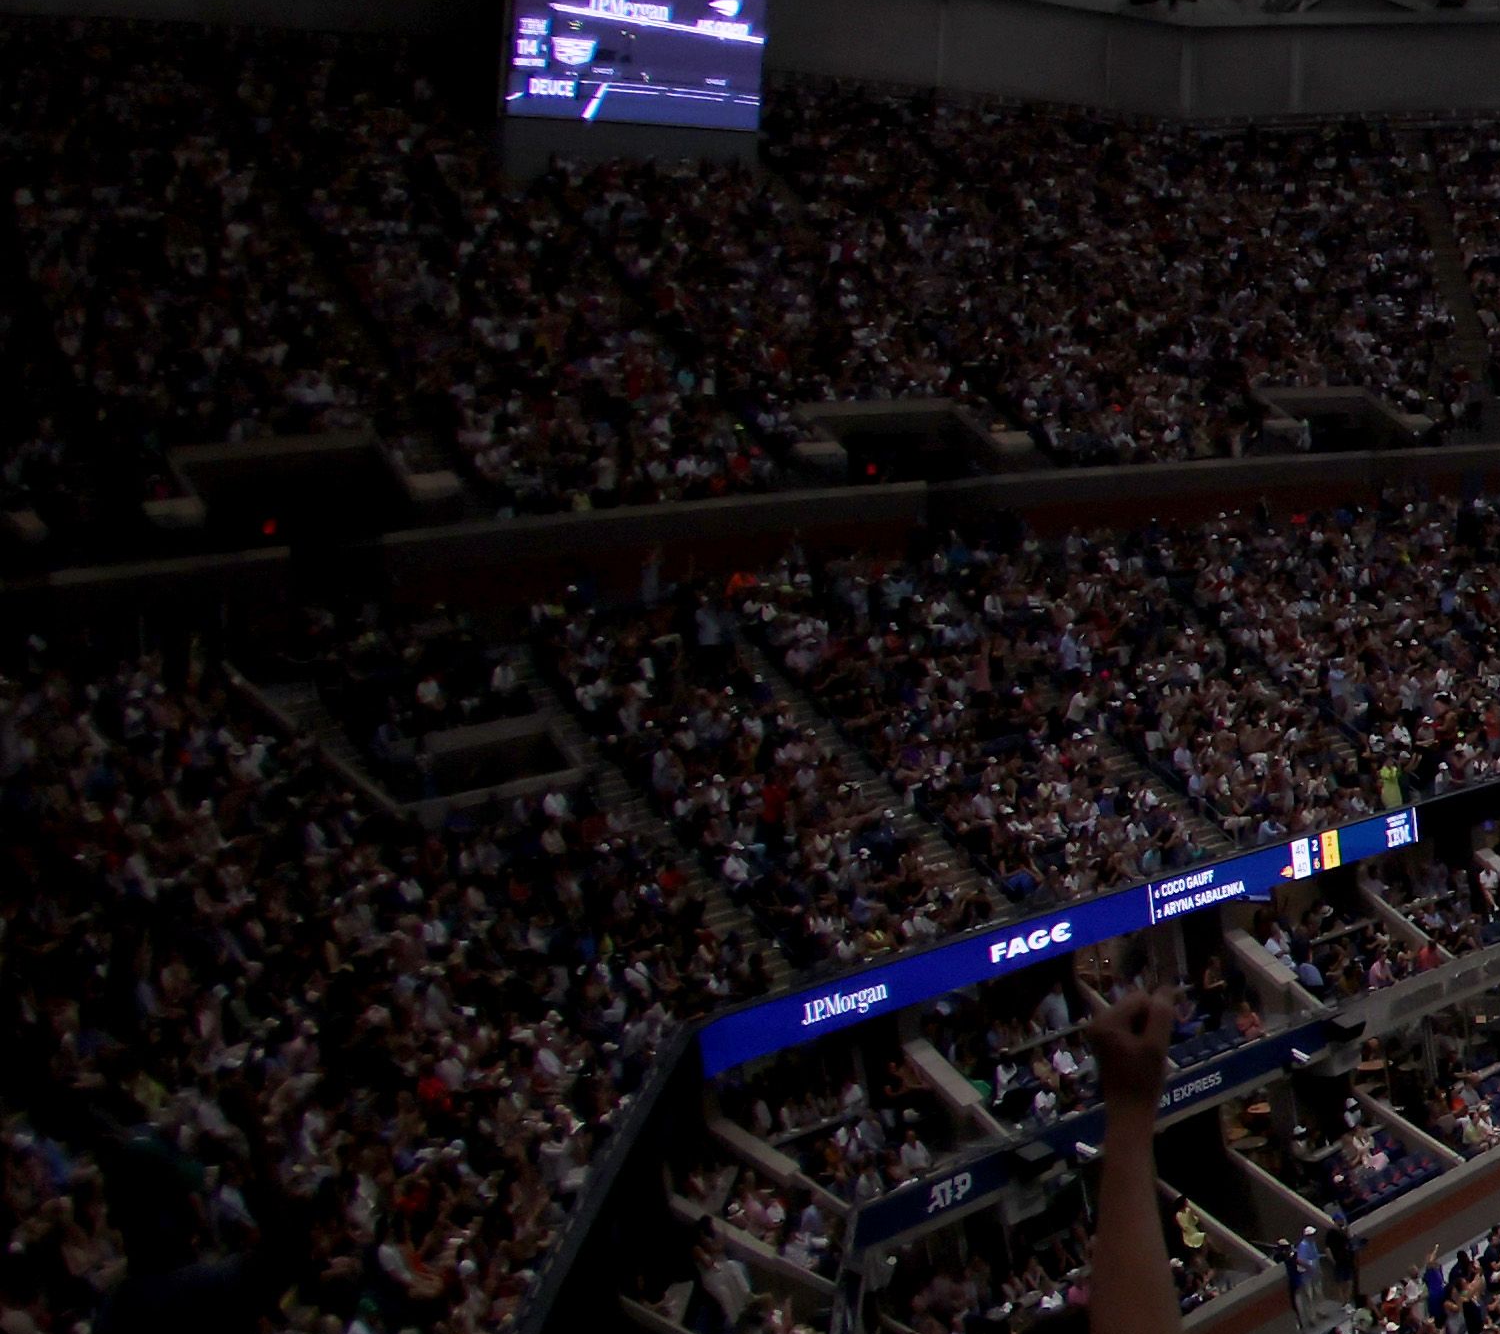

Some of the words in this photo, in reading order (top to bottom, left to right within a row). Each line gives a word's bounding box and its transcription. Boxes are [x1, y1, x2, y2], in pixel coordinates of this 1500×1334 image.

[528, 77, 576, 97] DEUCE
[1310, 839, 1319, 852] 2
[1385, 824, 1412, 848] IBM
[1161, 878, 1185, 897] COCO
[1186, 869, 1214, 889] GAUFF
[1164, 896, 1195, 917] ARYNA
[1194, 880, 1245, 907] SABALENKA
[989, 922, 1072, 964] FAGE
[801, 983, 888, 1025] J.P.Morgan
[1173, 1070, 1223, 1103] EXPRESS
[926, 1171, 972, 1214] ATP
